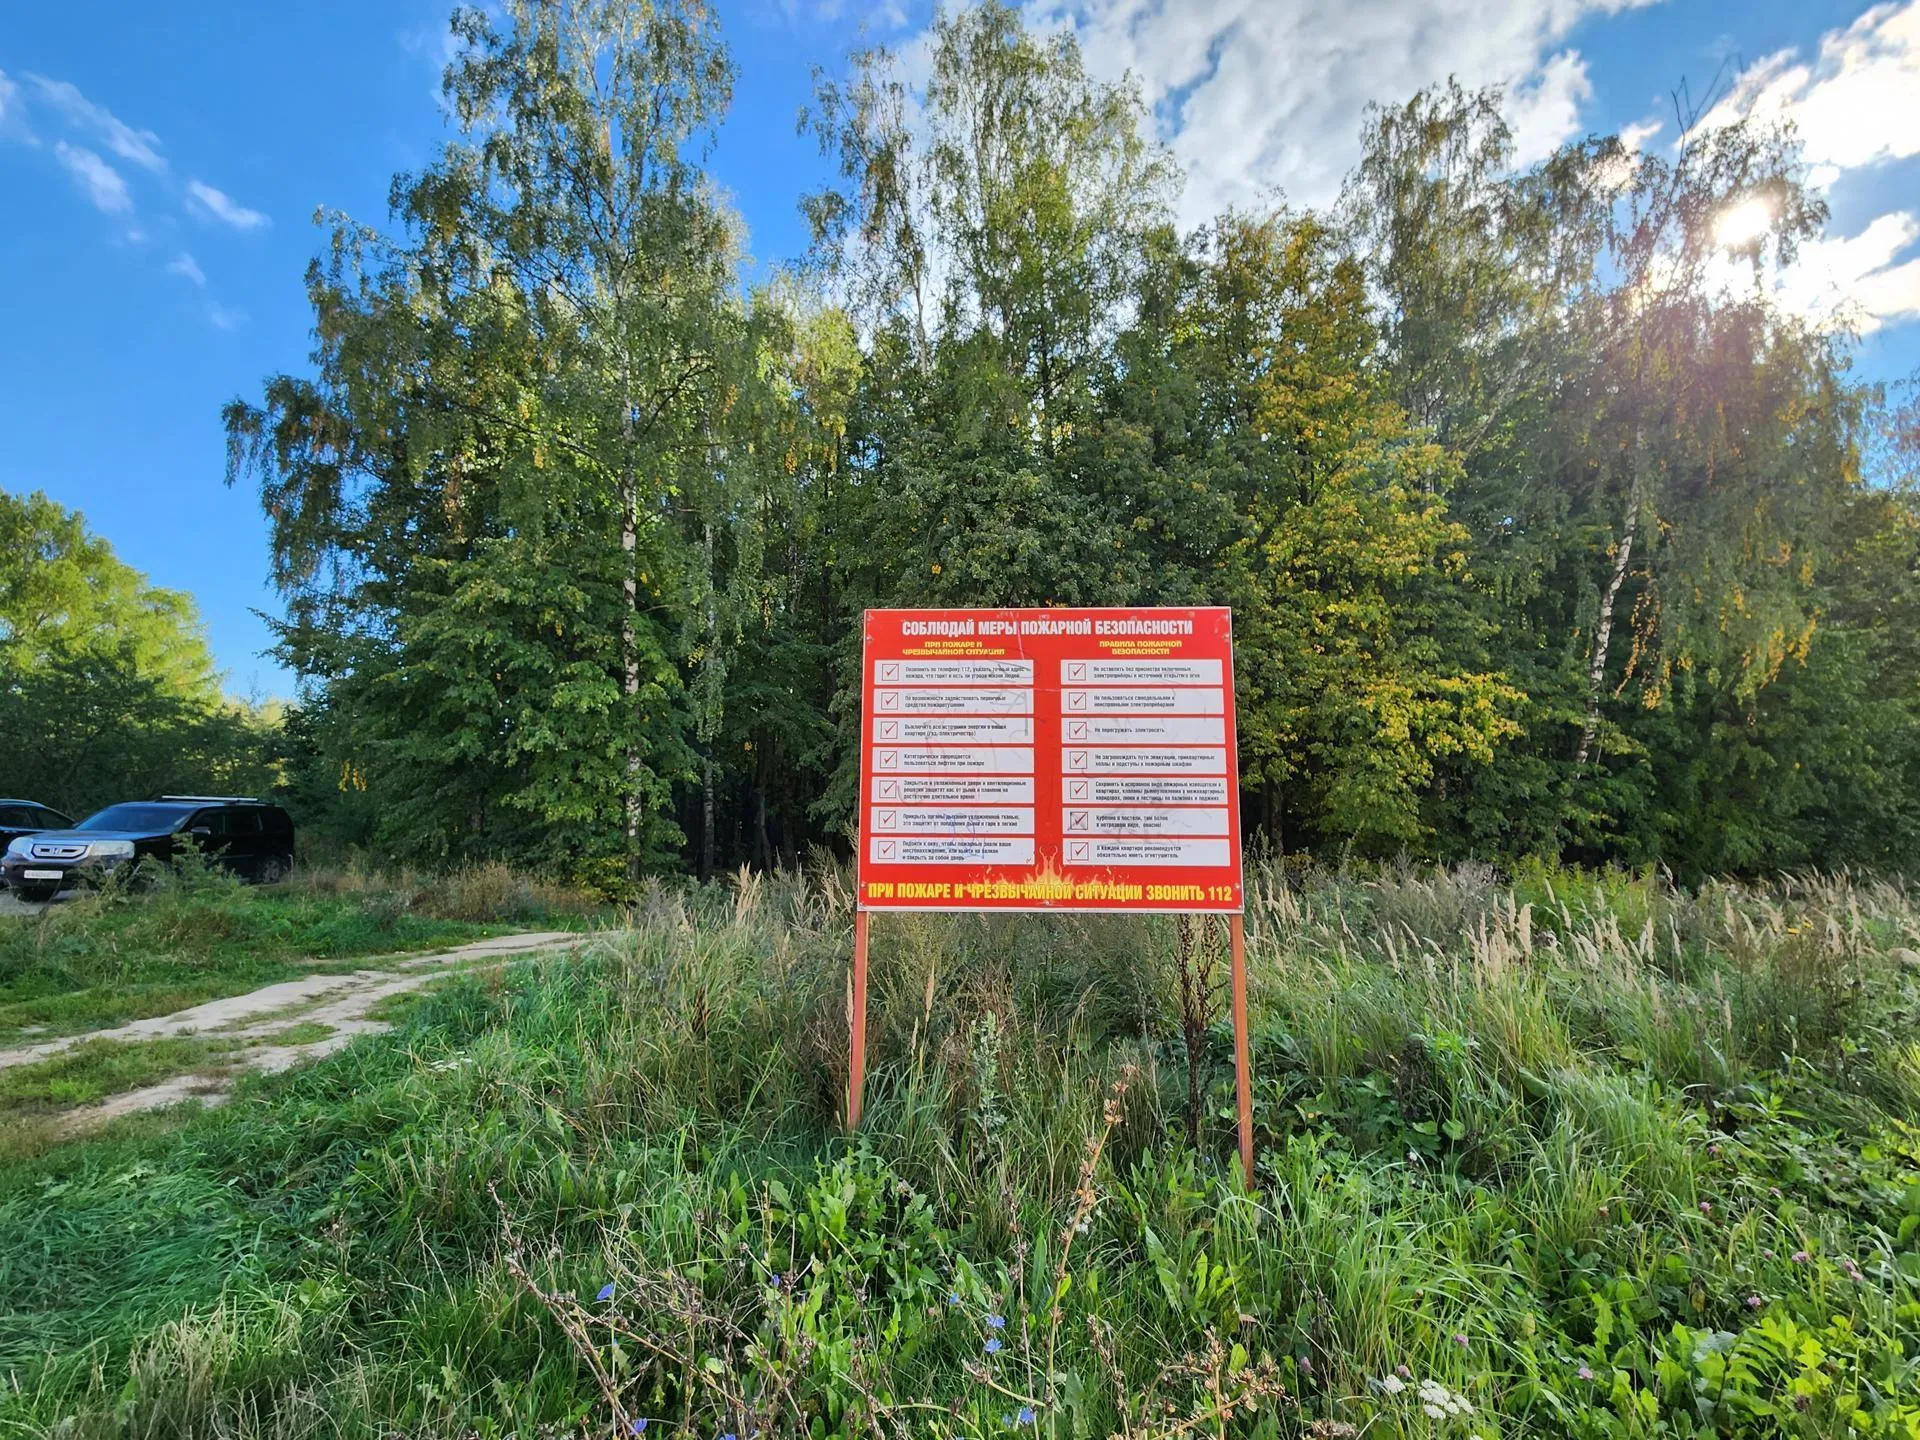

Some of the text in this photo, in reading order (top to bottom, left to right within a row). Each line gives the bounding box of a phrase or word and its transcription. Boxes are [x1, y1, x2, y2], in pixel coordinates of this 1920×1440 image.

[902, 618, 1193, 638] СОБЛЮДАЙ МЕРЫ ПОЖАРНОЙ БЕЗОПАСНОСТИ
[868, 883, 1232, 902] ПРИ ПОЖАРЕ И ЧРЕЗВЫЧАЙНОЙ СИТУАЦИИ ЗВОНИТЬ 112
